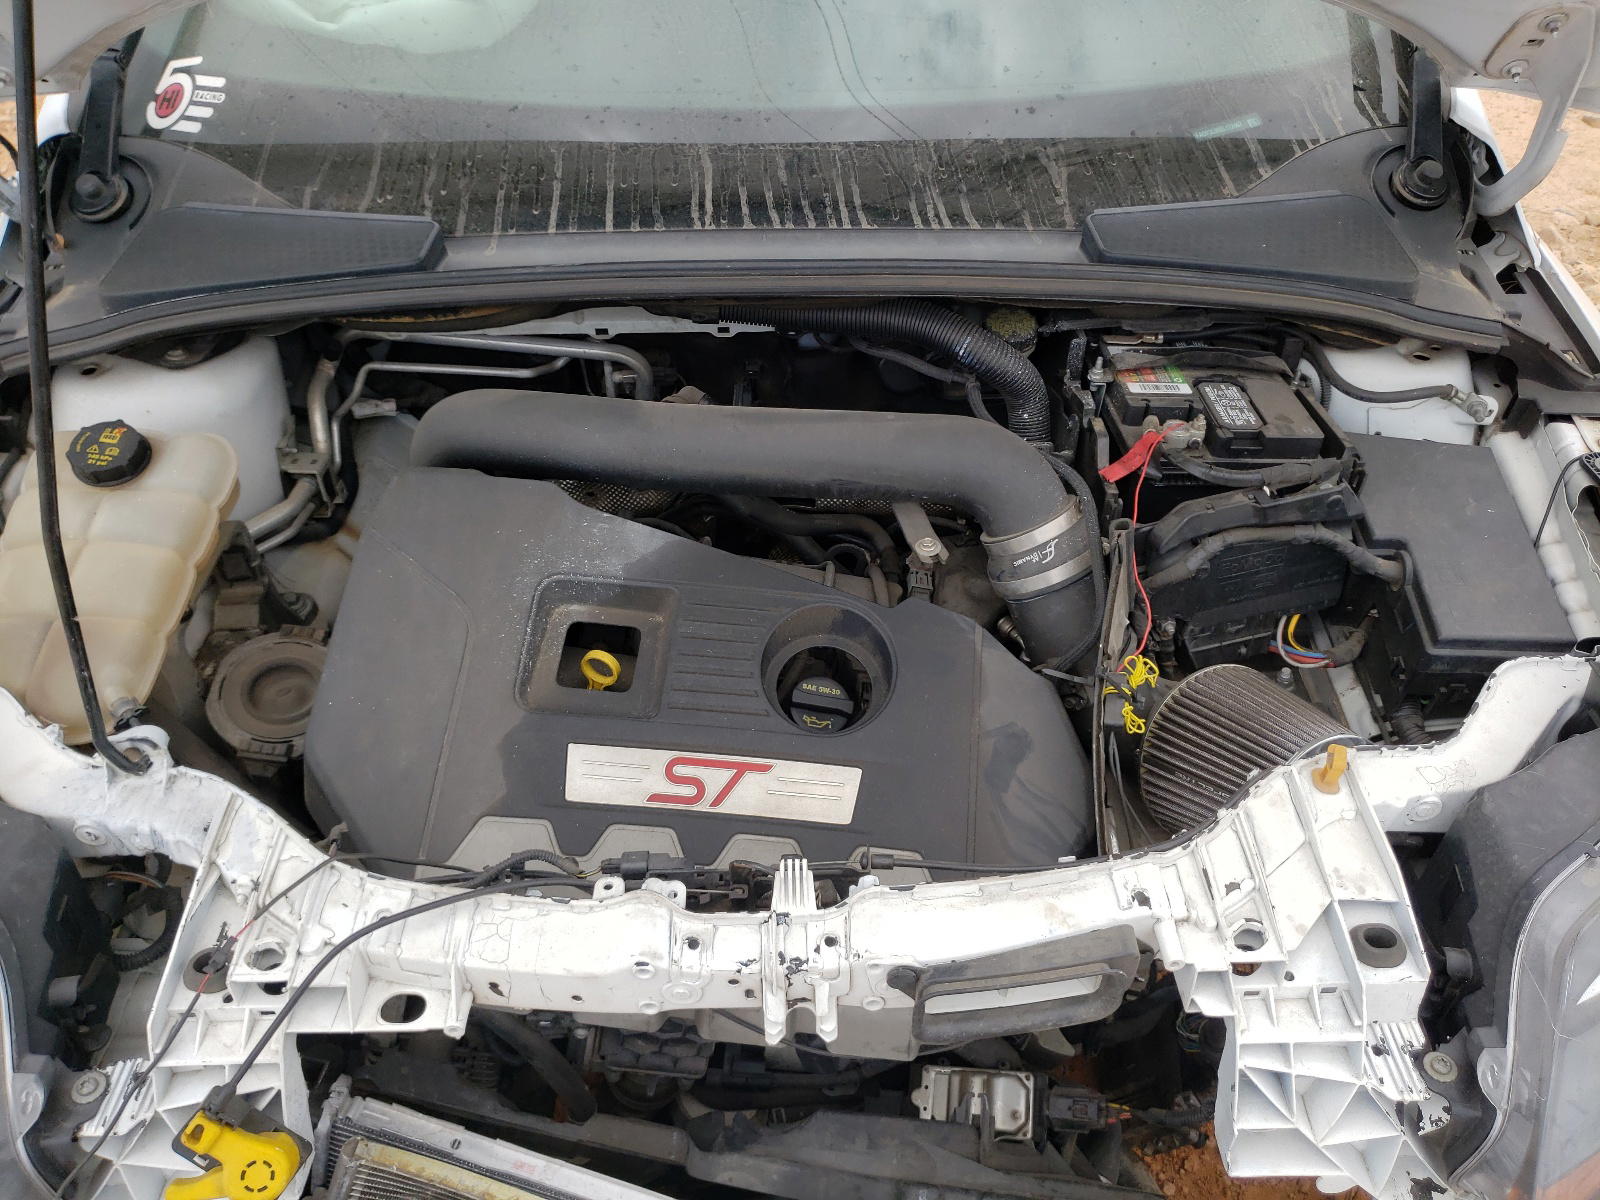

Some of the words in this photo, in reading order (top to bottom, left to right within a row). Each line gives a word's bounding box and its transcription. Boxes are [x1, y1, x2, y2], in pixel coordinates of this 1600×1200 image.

[159, 89, 181, 111] HI
[194, 92, 224, 103] RACING
[802, 683, 817, 692] SAE
[818, 686, 841, 696] 5W-30
[644, 755, 778, 808] ST
